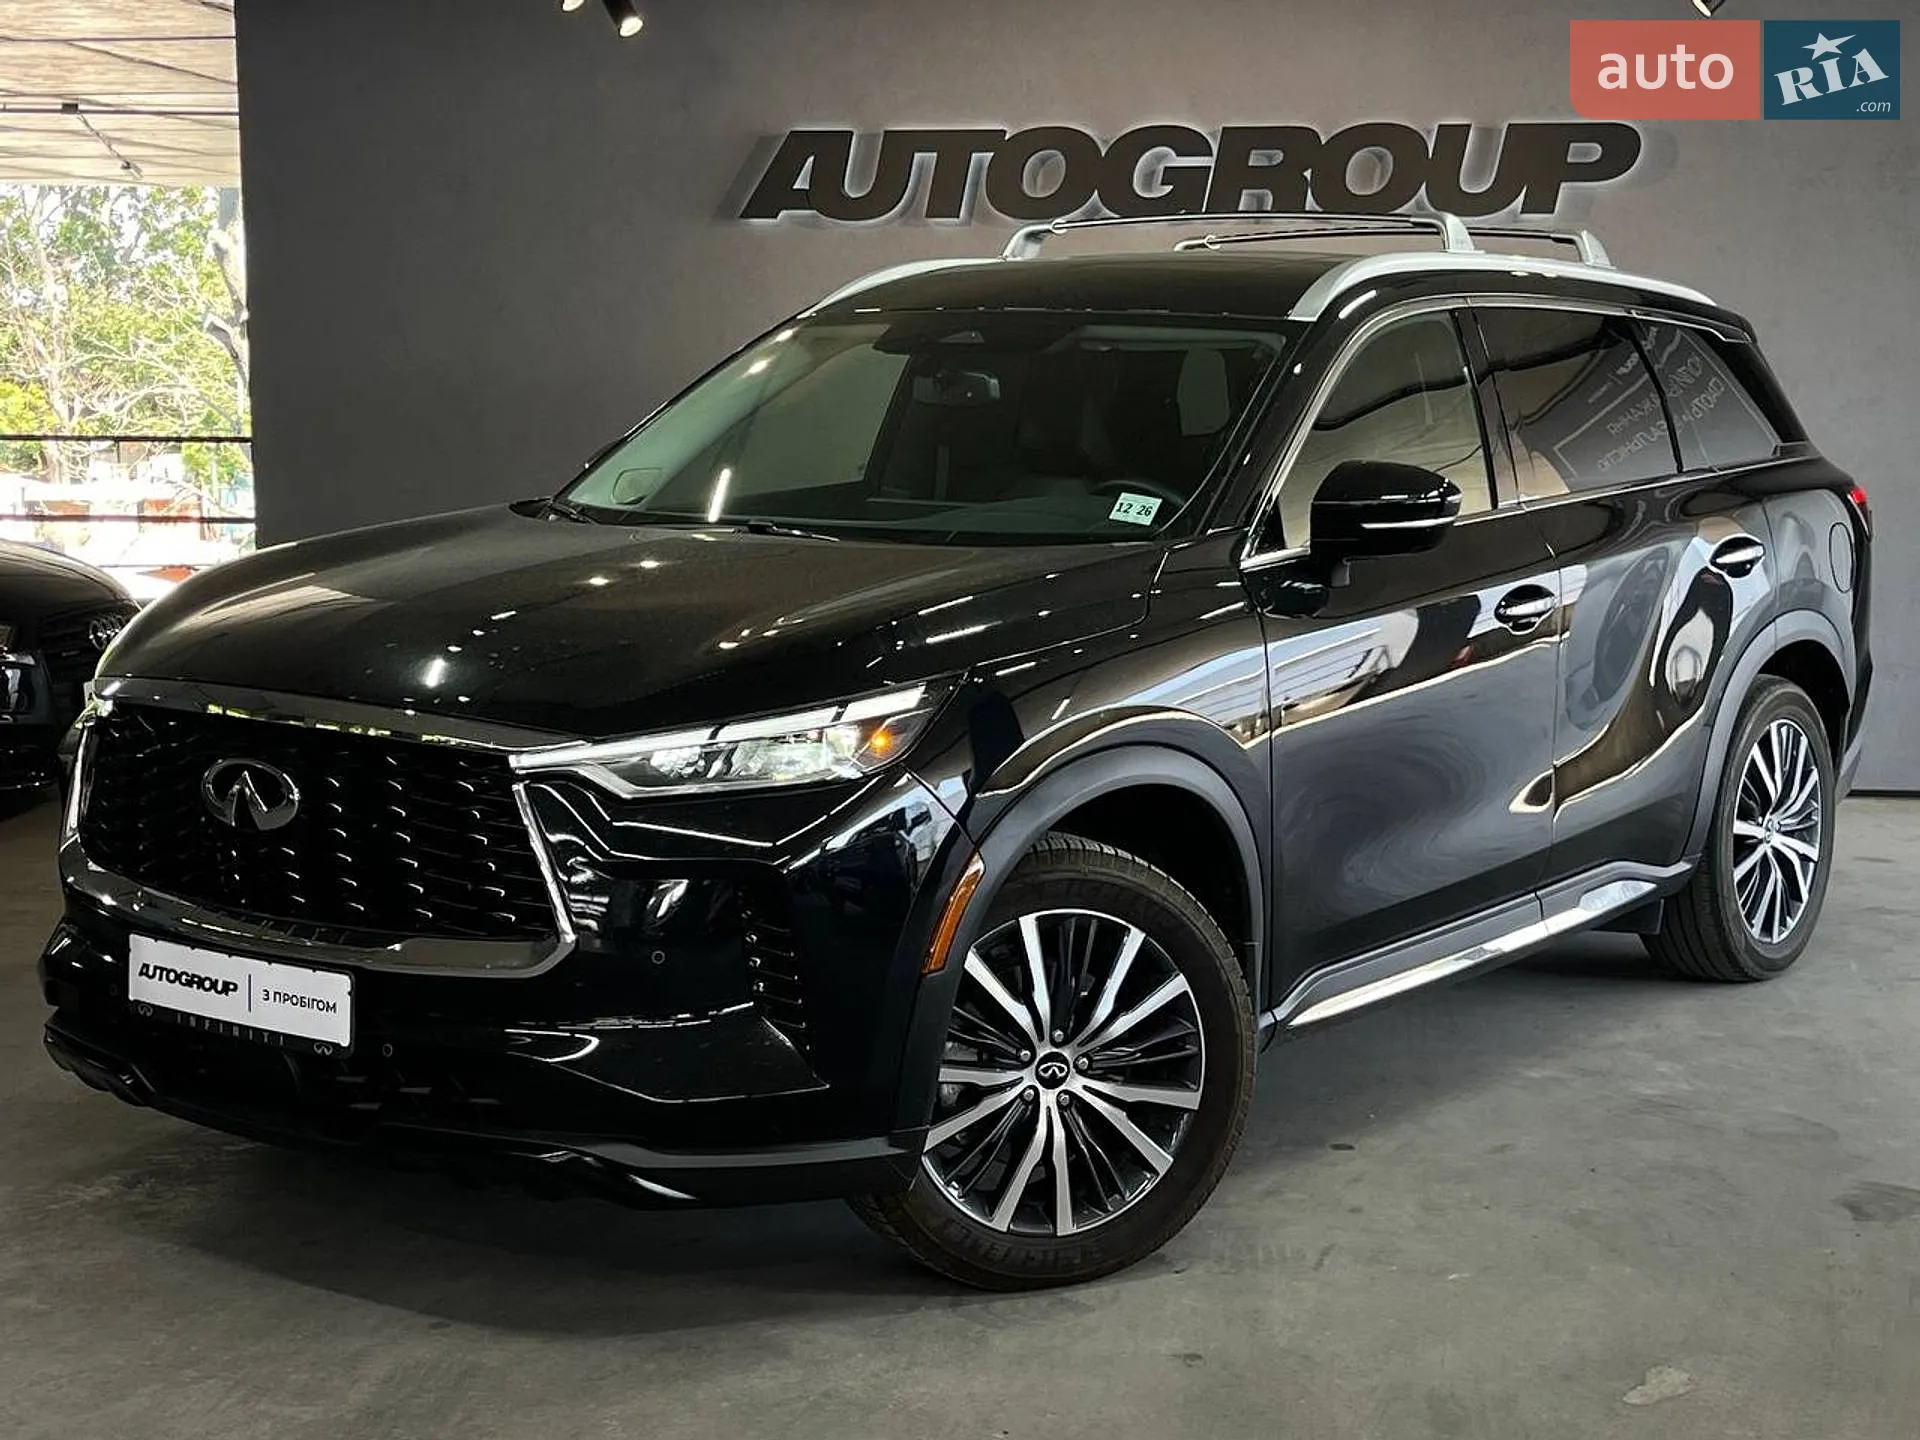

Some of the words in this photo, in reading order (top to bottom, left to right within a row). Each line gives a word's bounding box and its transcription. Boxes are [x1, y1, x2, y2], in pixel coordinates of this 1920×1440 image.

[739, 123, 1641, 221] AUTOGROUP
[1116, 502, 1133, 514] 12
[1136, 505, 1152, 517] 26
[138, 962, 238, 997] AUTOGROUP
[273, 991, 337, 1014] ПРОБІГОМ
